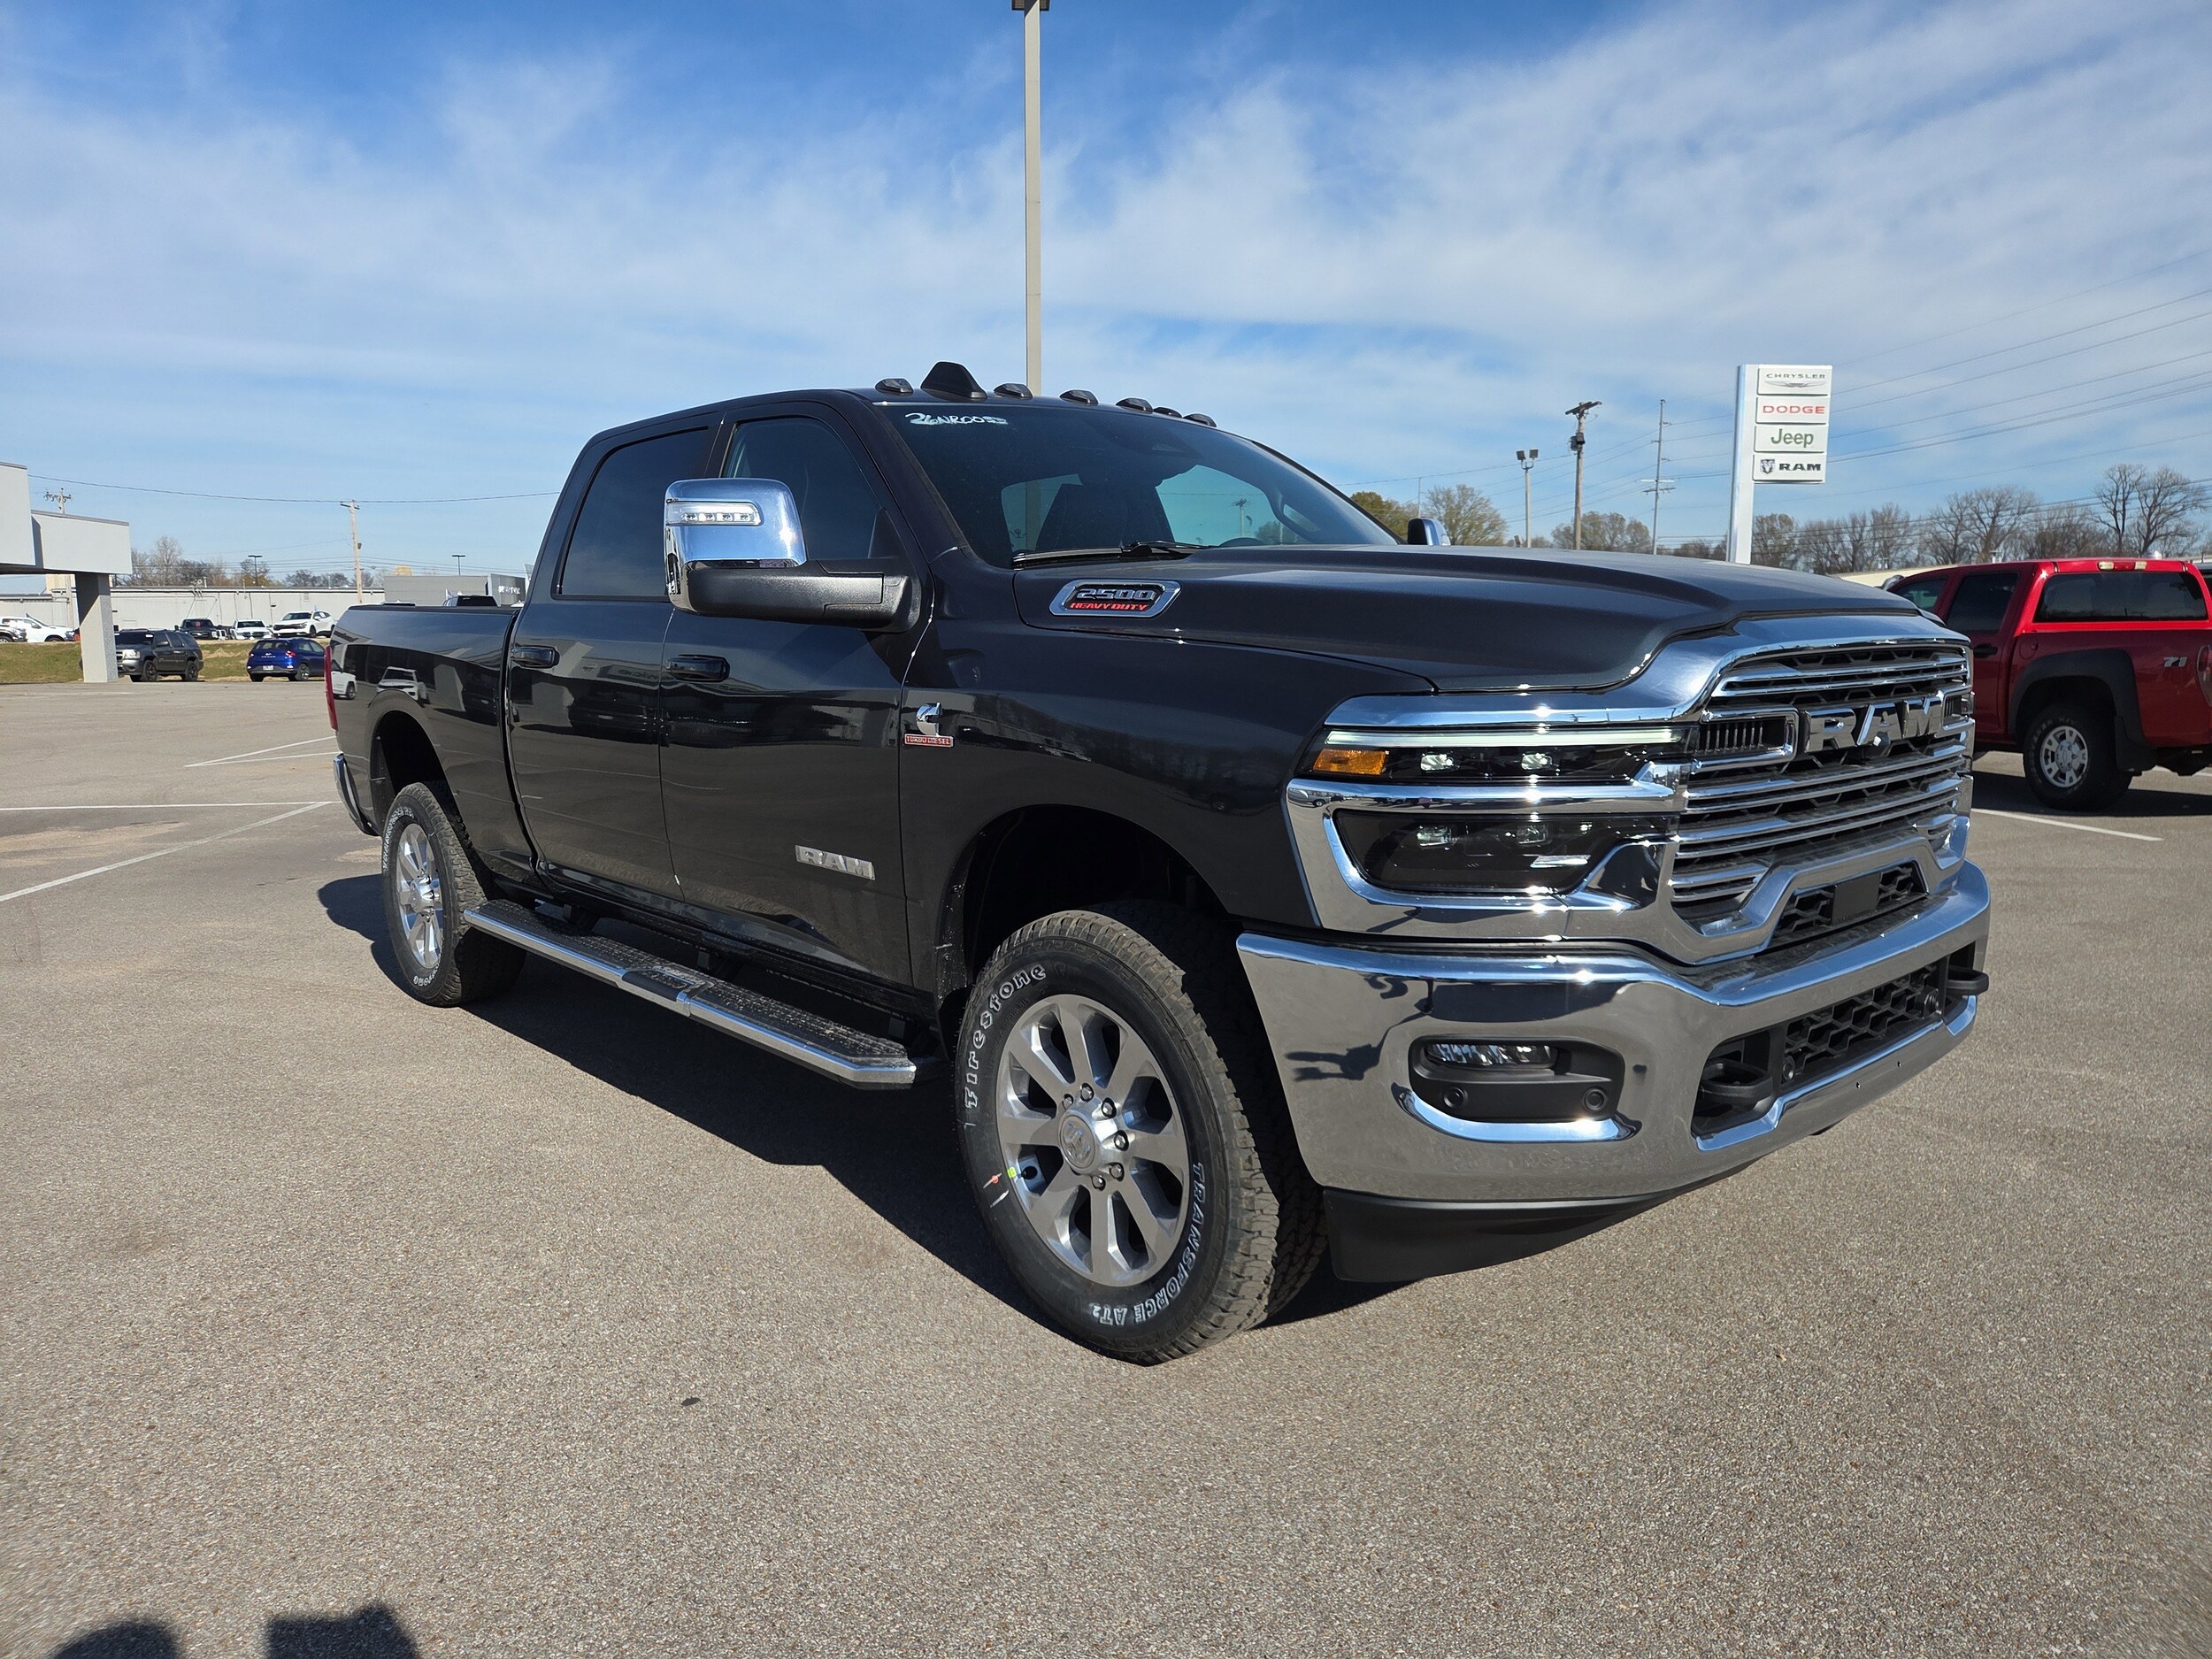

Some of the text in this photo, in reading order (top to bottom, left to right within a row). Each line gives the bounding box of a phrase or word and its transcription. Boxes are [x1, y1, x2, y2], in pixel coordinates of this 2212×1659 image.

[1763, 405, 1825, 414] DODGE
[1770, 428, 1814, 448] Jeep
[1076, 588, 1156, 601] 2500
[1803, 695, 1944, 752] RAM
[795, 845, 875, 880] RAM
[964, 964, 1047, 1109] Firestone
[1133, 1162, 1206, 1323] TRANSFORCE
